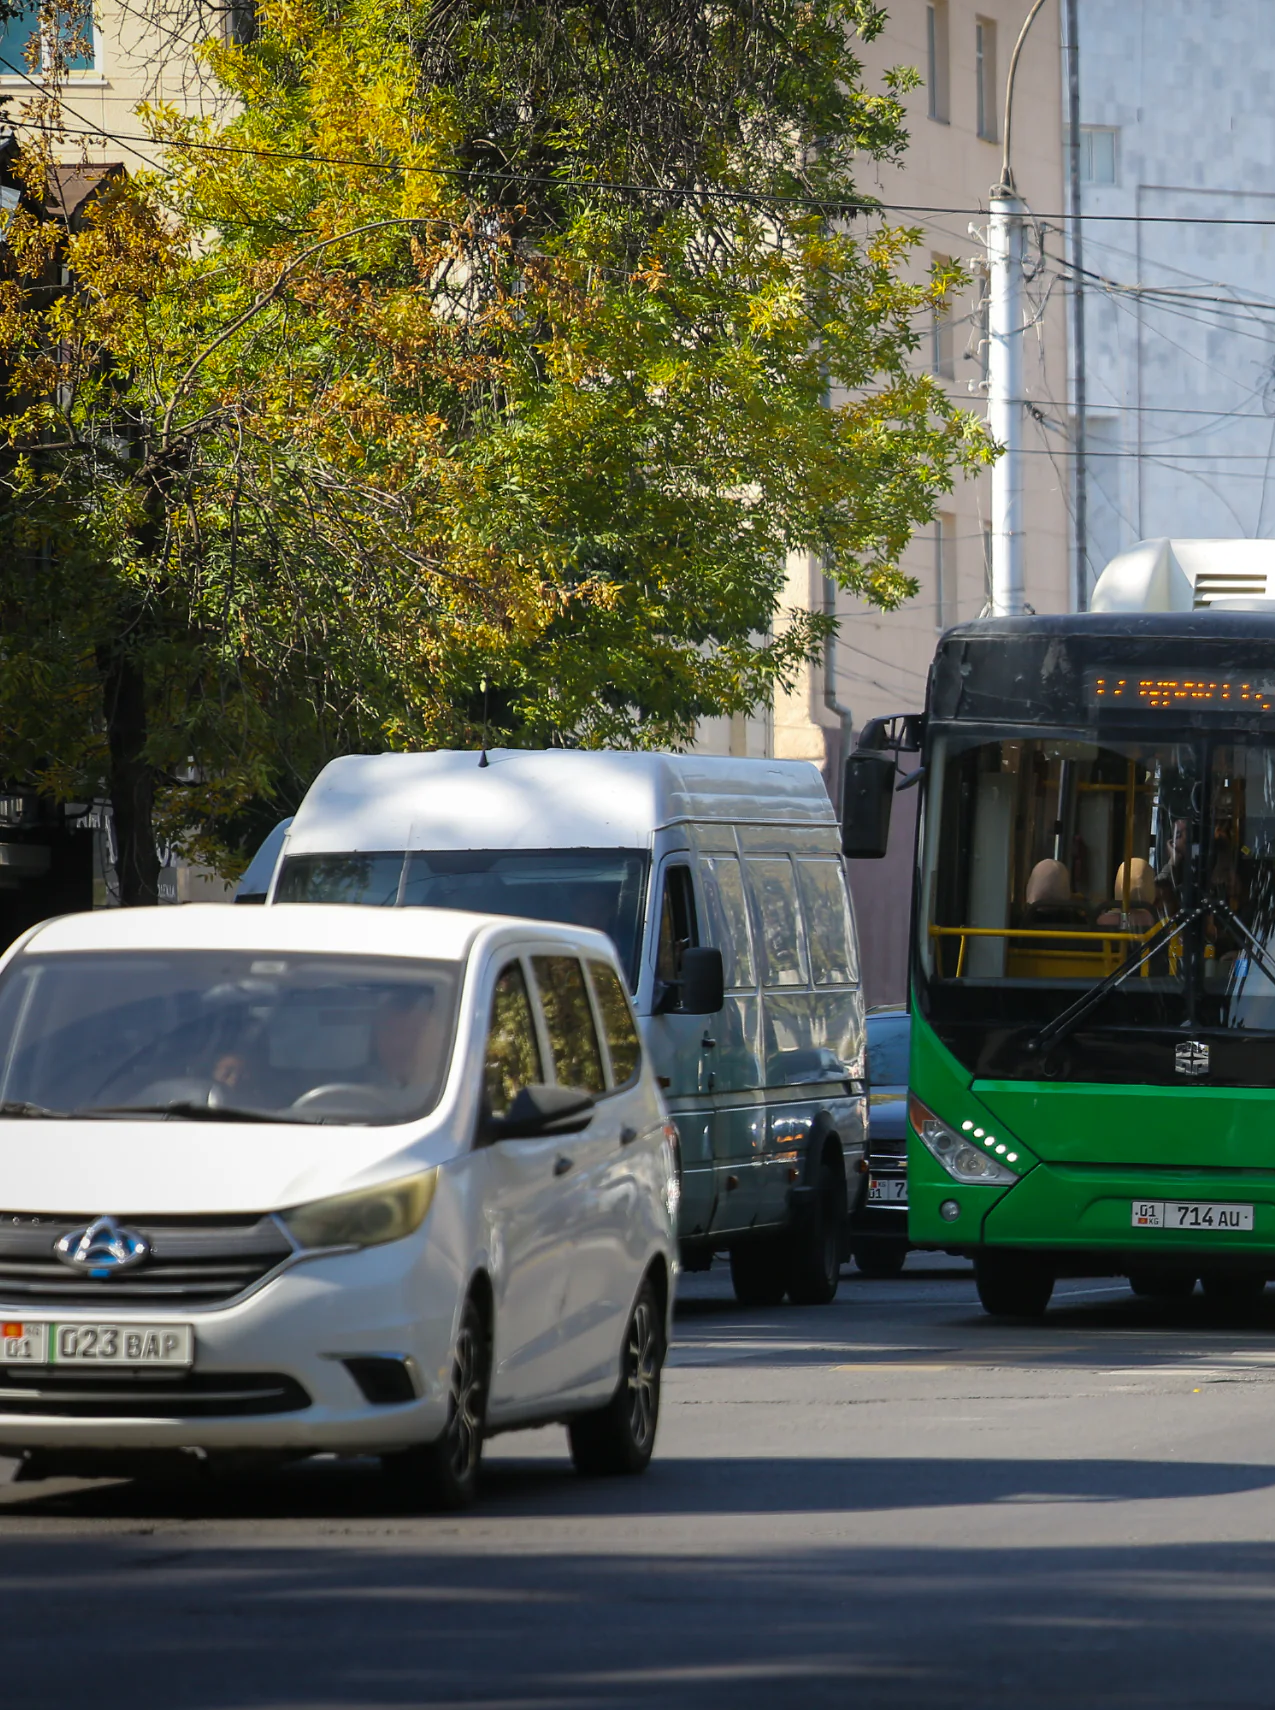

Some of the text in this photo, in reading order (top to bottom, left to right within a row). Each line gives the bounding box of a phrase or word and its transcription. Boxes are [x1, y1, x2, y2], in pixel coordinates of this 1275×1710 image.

[1140, 1204, 1156, 1217] 01
[1177, 1206, 1240, 1227] 714 AU
[4, 1336, 31, 1357] 01
[57, 1324, 179, 1359] 023 BAP
